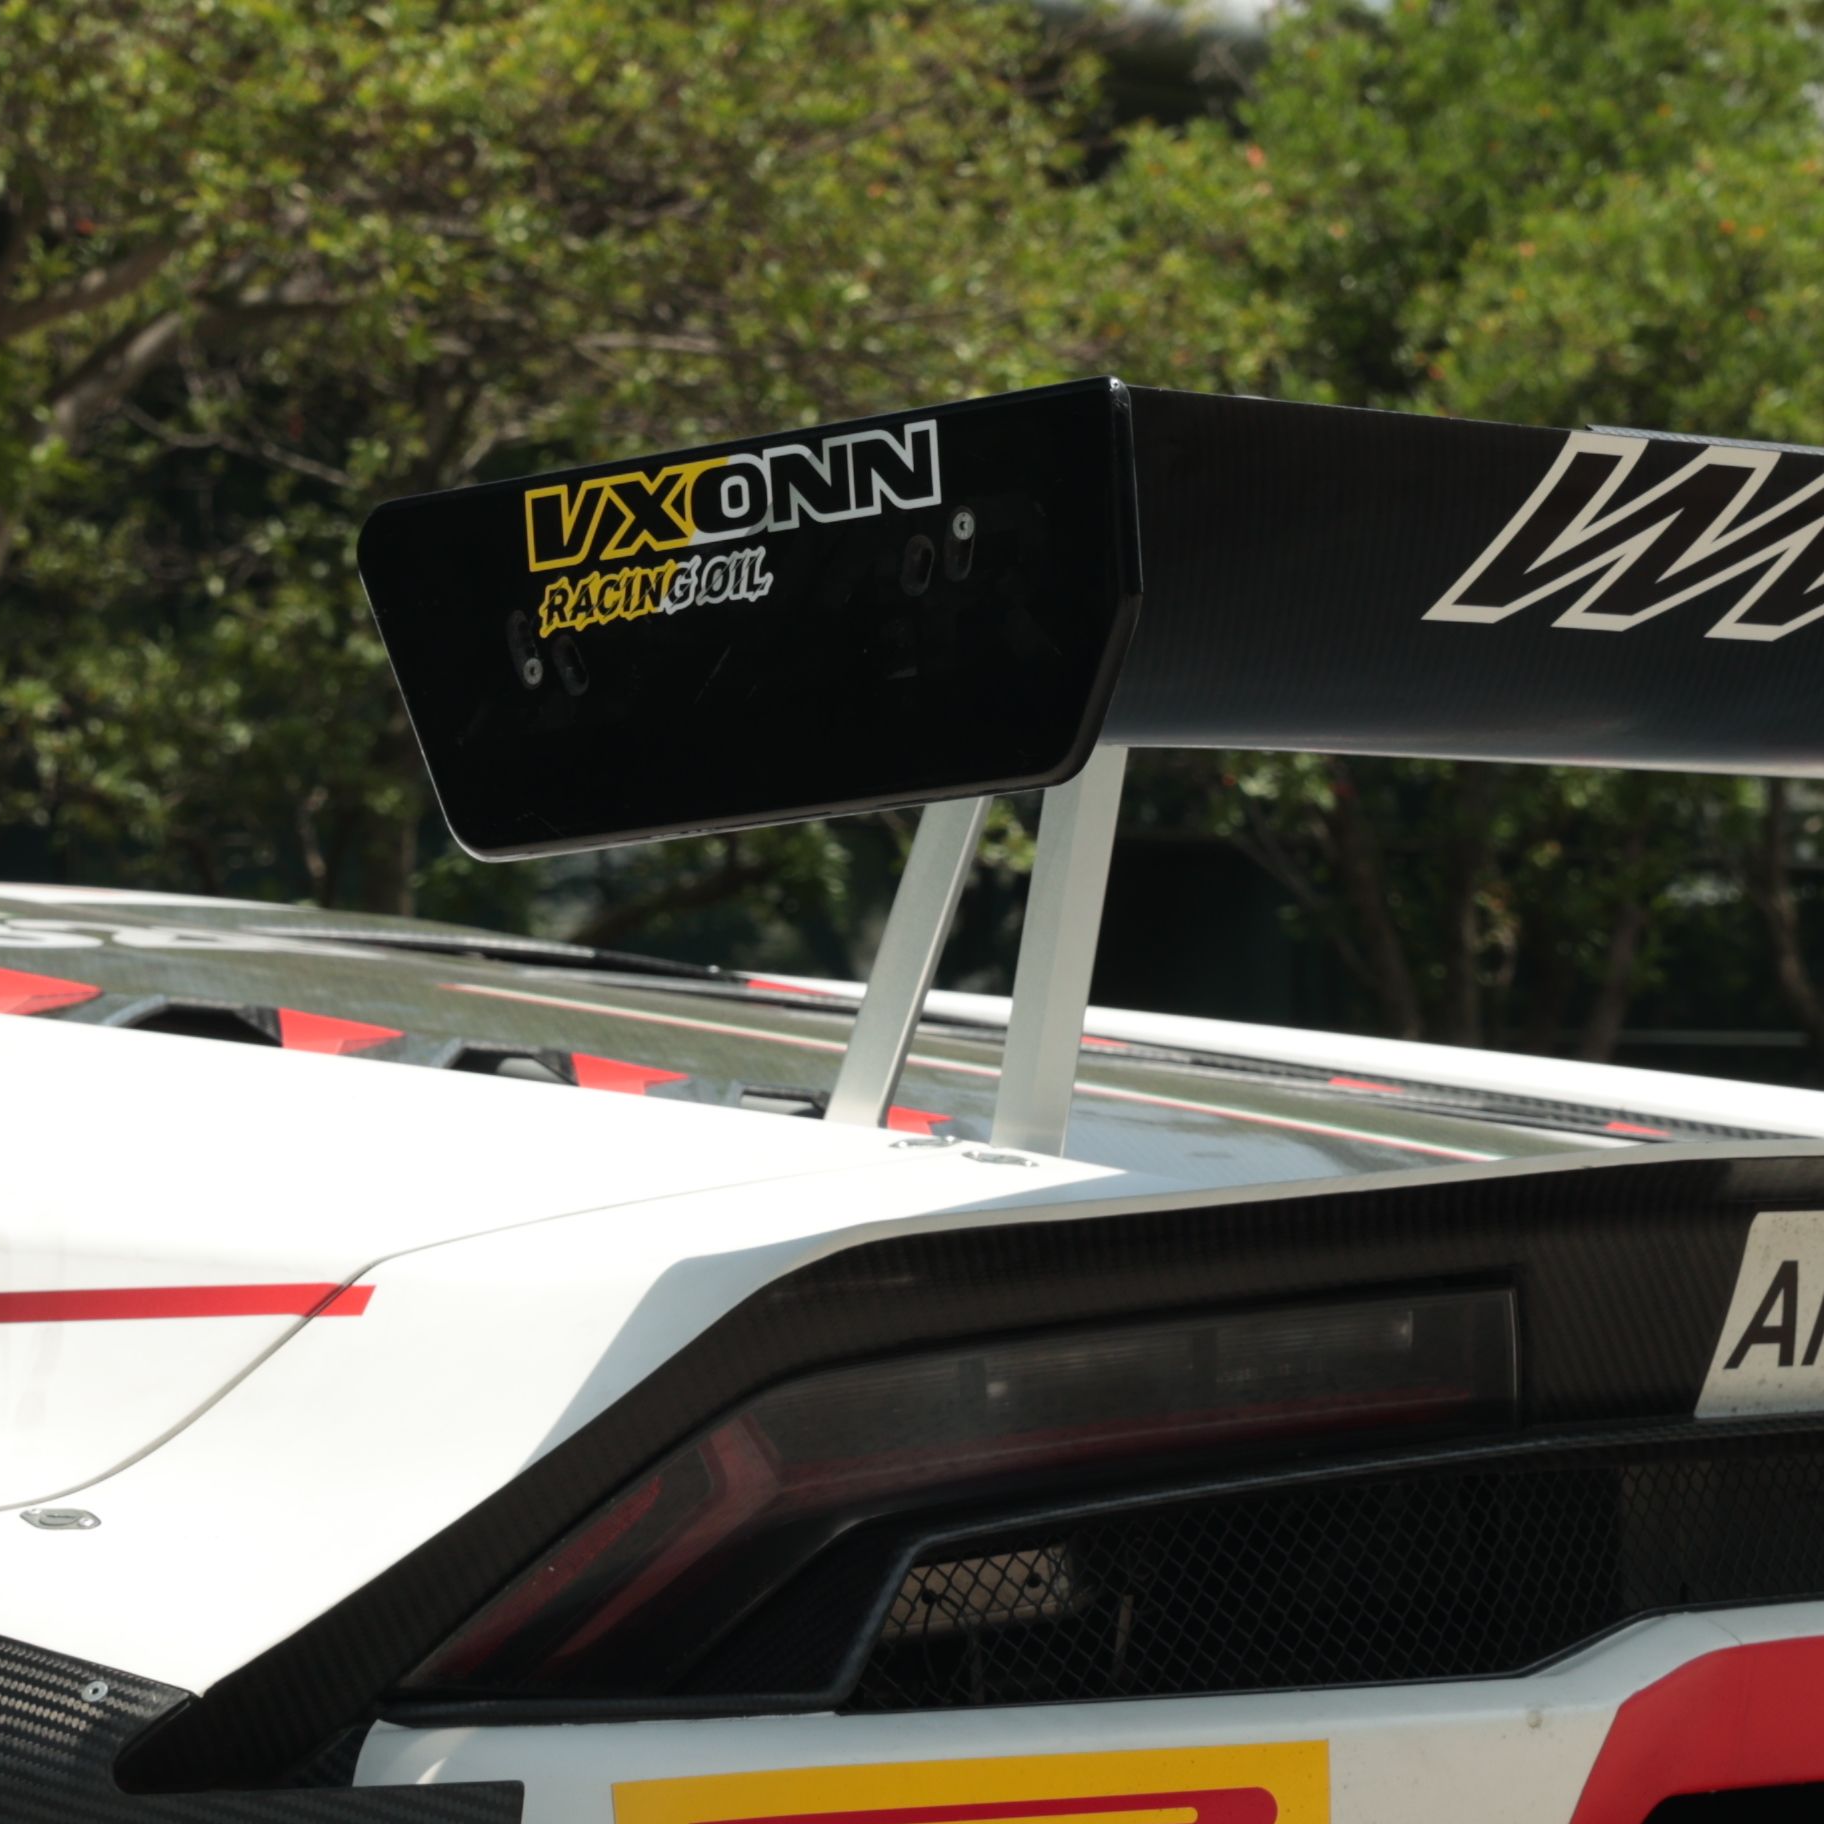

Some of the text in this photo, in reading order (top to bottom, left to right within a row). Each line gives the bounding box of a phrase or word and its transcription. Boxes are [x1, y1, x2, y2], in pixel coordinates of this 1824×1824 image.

[525, 419, 942, 572] VXONN
[539, 546, 773, 639] RACING OIL
